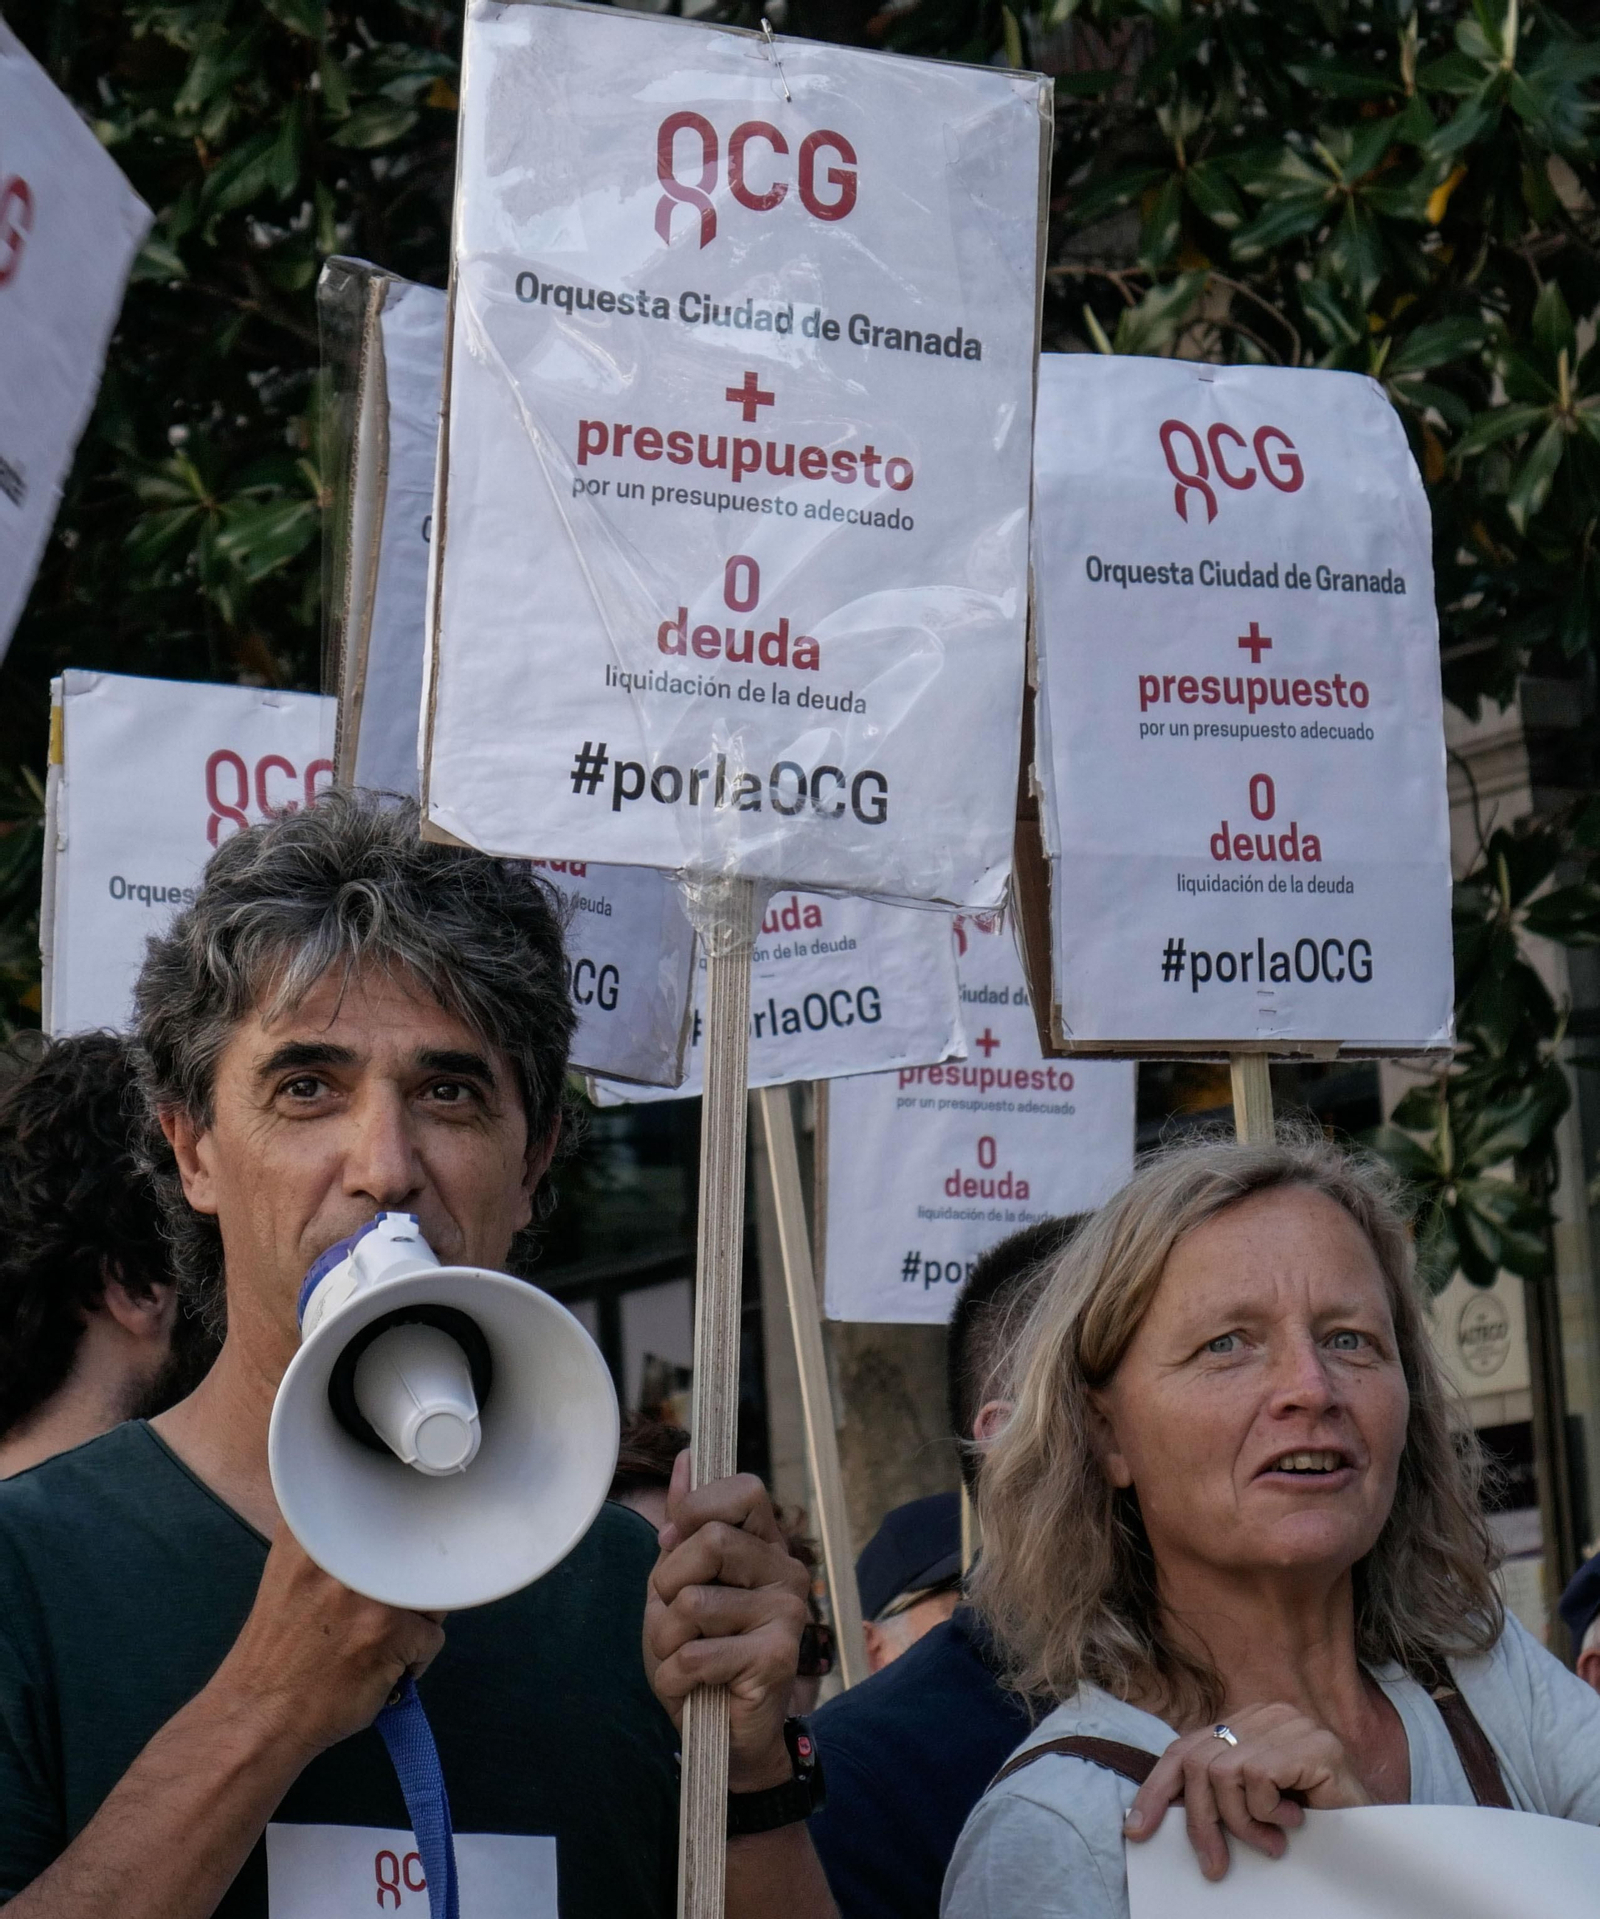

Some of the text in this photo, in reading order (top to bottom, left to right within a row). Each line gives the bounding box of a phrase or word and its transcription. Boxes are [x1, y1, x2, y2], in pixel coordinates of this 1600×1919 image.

[655, 111, 857, 249] OCG
[515, 271, 982, 361] Orquesta Ciudad de Granada
[577, 419, 914, 491] presupuesto
[1160, 419, 1304, 524] OCG
[573, 476, 914, 532] por un presupuesto adecuado
[723, 555, 759, 611] 0
[1086, 555, 1407, 595] Orquesta Ciudad de Granada
[657, 607, 820, 671] deuda
[605, 665, 866, 714] liquidación de la deuda
[1139, 673, 1370, 714] presupuesto
[1140, 721, 1375, 741] por un presupuesto adecuado
[205, 749, 333, 849] OC
[570, 741, 888, 825] #porlaOCG
[1249, 773, 1275, 821] 0
[1210, 820, 1322, 863] deuda
[1177, 873, 1354, 895] liquidación de la deuda
[762, 896, 823, 934] uda
[773, 944, 792, 960] de
[794, 941, 807, 957] la
[811, 935, 857, 953] deuda
[1162, 938, 1373, 993] #porlaOCG
[898, 1065, 1074, 1093] presupuesto
[896, 1097, 1076, 1116] por un presupuesto adecuado
[977, 1136, 997, 1170] 0
[944, 1168, 1030, 1201] deuda
[917, 1206, 986, 1222] liquidación
[987, 1208, 1003, 1221] de
[1005, 1209, 1015, 1222] la
[375, 1850, 426, 1910] OC
